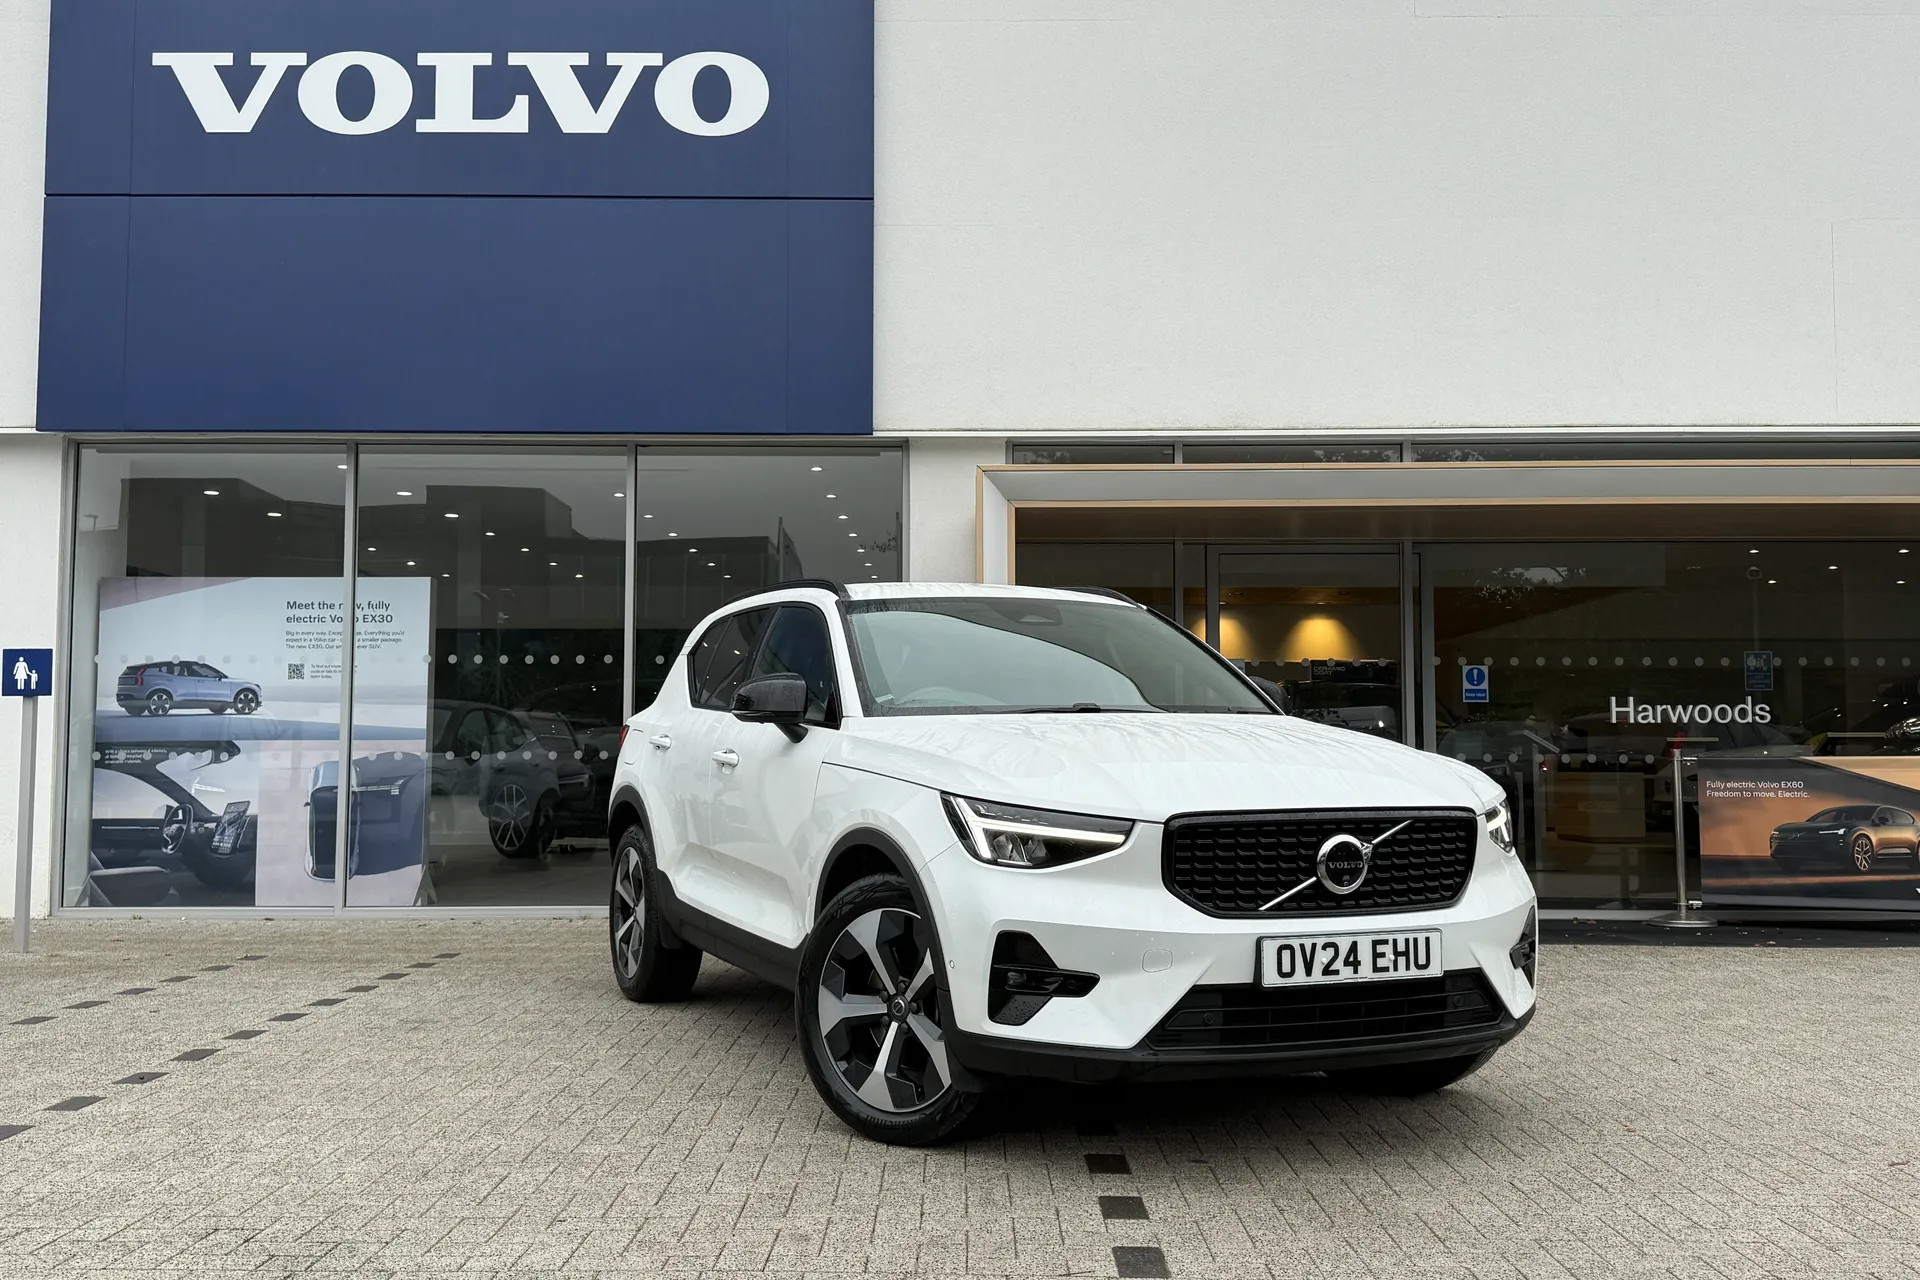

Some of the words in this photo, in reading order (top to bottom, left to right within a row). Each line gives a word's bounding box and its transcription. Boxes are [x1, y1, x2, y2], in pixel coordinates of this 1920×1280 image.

[152, 51, 770, 137] VOLVO
[286, 601, 315, 610] Meet
[318, 601, 335, 610] the
[367, 601, 390, 611] fully
[286, 614, 326, 623] electric
[363, 614, 393, 623] EX30
[1610, 696, 1772, 724] Harwoods
[1706, 781, 1725, 789] Fully
[1778, 790, 1810, 798] Electric.
[1327, 861, 1364, 869] VOLVO
[1276, 940, 1362, 979] OV24
[1371, 936, 1431, 974] EHU
